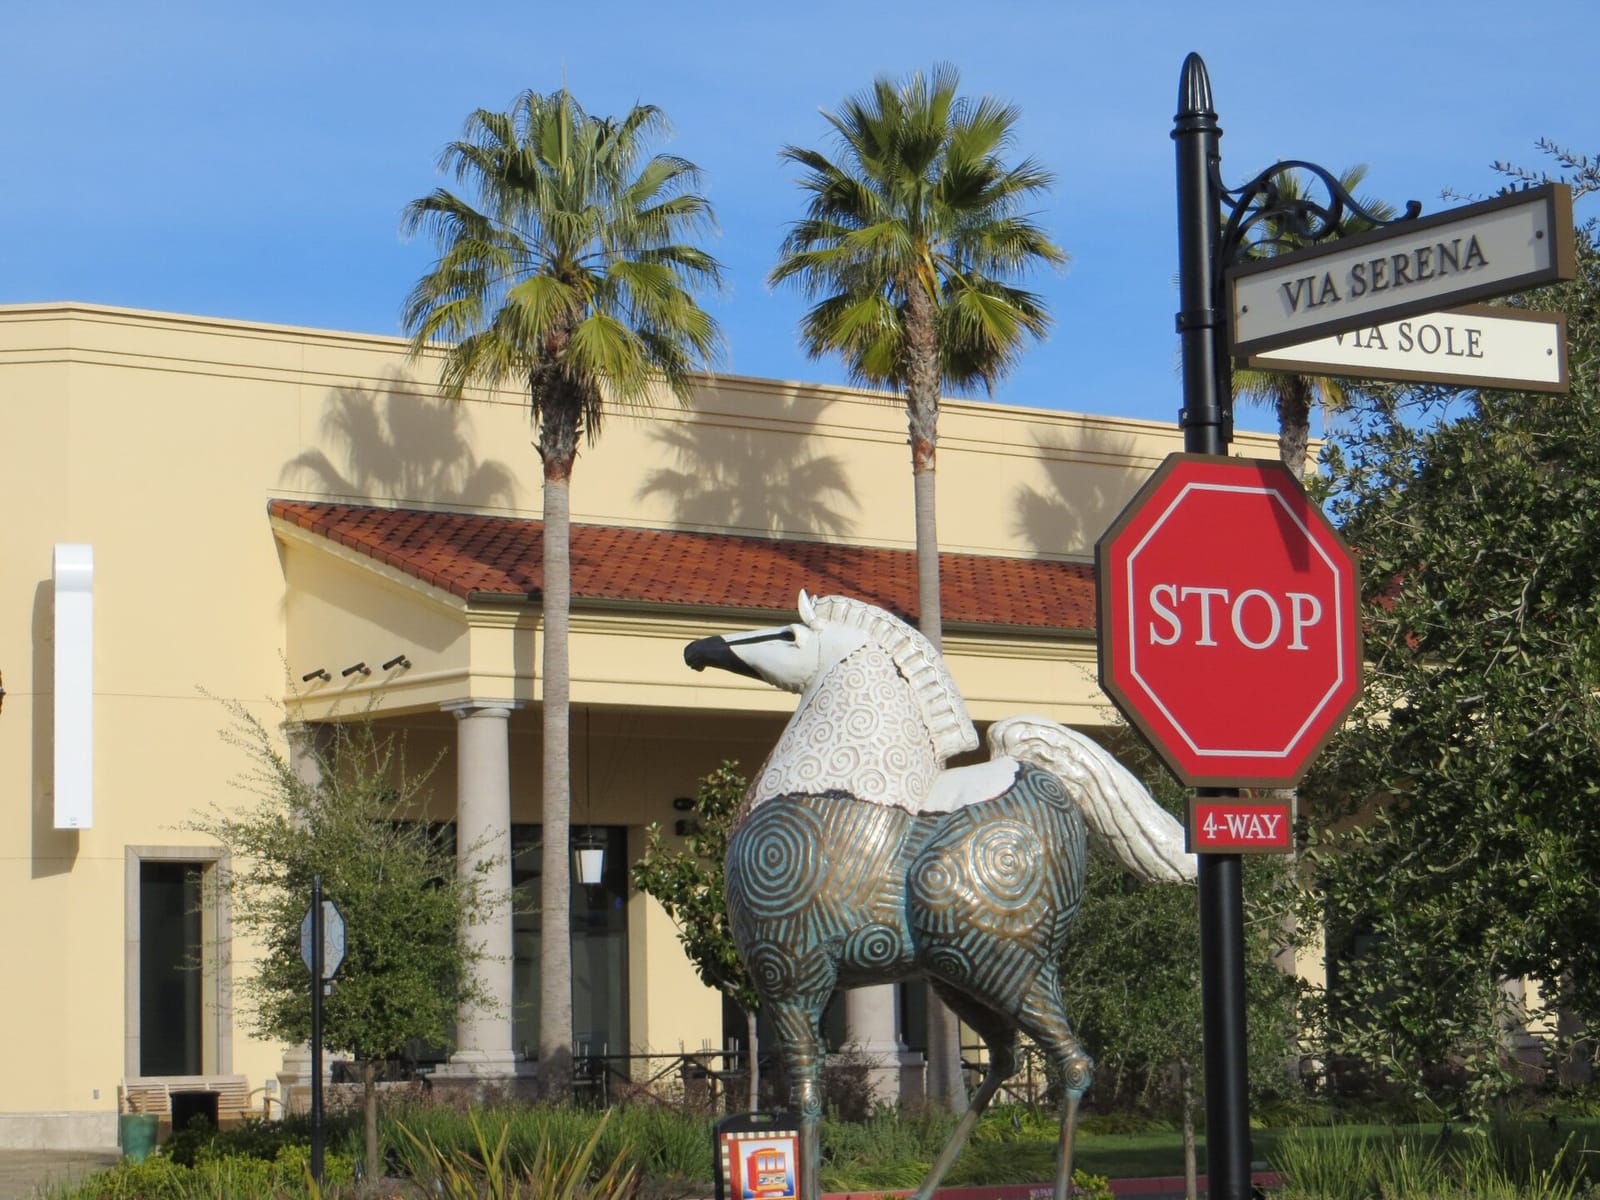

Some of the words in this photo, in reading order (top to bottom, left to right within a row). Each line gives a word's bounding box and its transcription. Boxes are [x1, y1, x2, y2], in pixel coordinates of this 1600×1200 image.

[1282, 271, 1341, 312] VIA
[1351, 234, 1488, 298] SERENA
[1398, 322, 1484, 358] SOLE
[1150, 584, 1322, 650] STOP
[1203, 812, 1281, 840] 4-WAY
